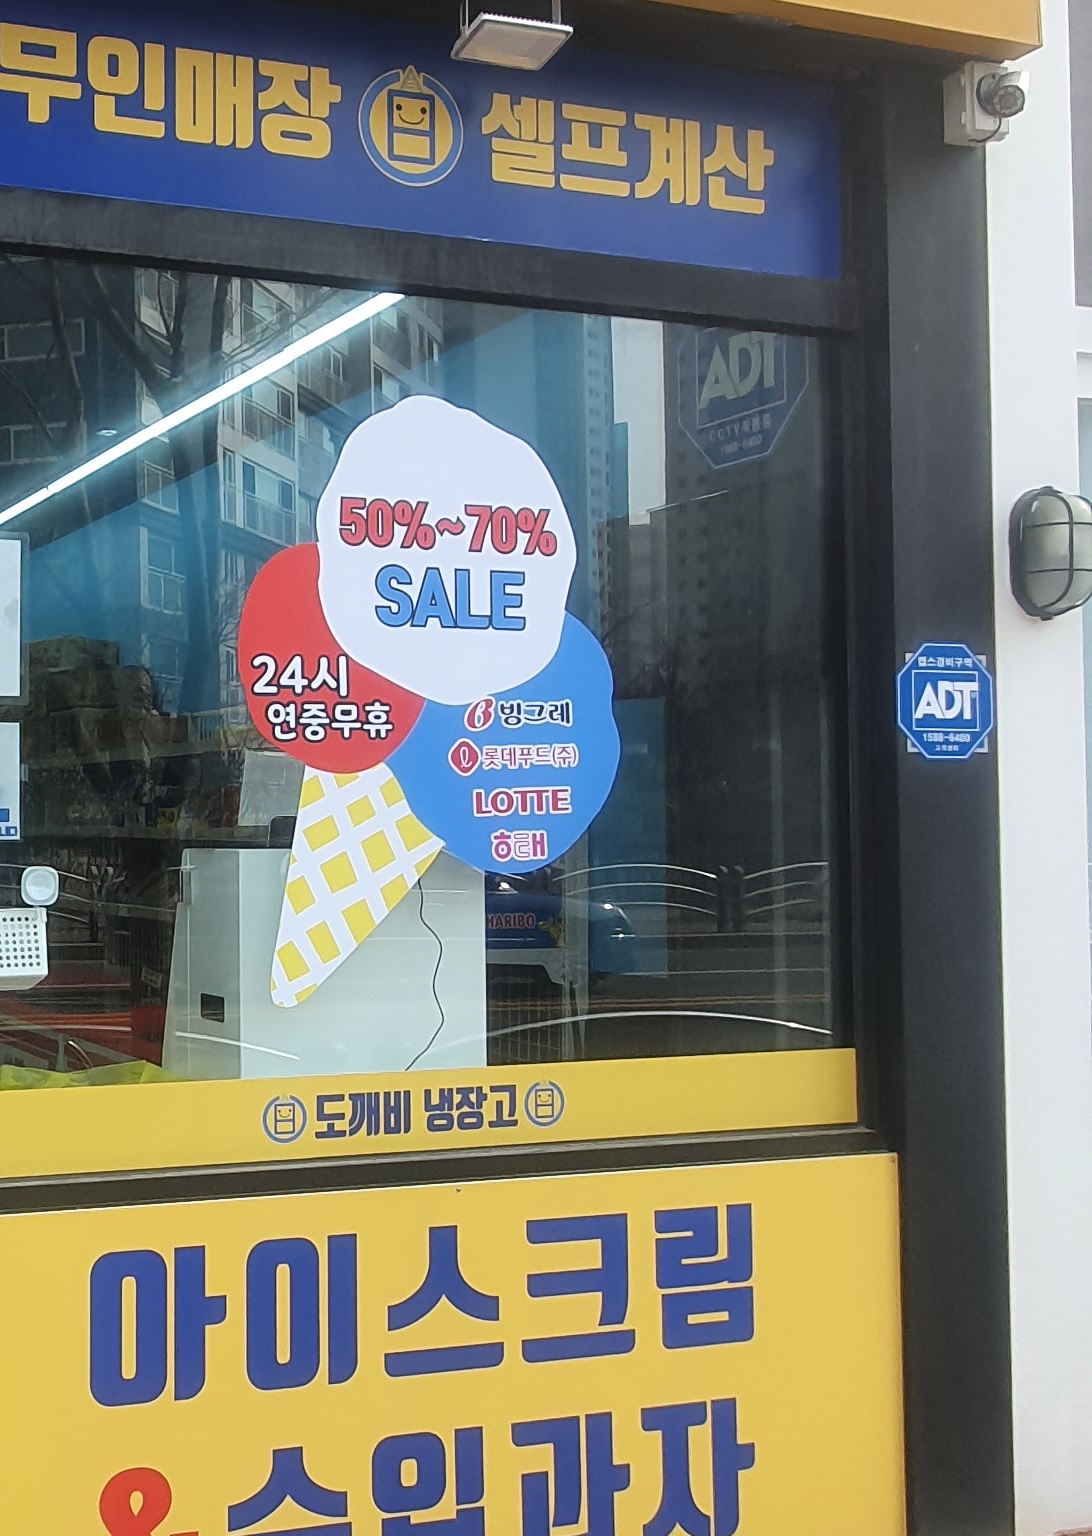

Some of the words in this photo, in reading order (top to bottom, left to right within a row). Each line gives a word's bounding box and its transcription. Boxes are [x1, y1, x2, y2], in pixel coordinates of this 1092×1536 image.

[480, 92, 775, 215] 셀프계산
[698, 330, 777, 409] ADT
[339, 496, 558, 556] 50%~70%
[374, 564, 527, 631] SALE
[251, 653, 349, 699] 24시
[266, 700, 395, 742] 연중무휴
[500, 701, 571, 726] 빙그레
[914, 680, 978, 719] ADT
[483, 745, 577, 768] 롯데푸드(주)
[475, 789, 570, 814] LOTTE
[486, 913, 535, 929] HARIBO
[314, 1089, 411, 1139] 도깨비
[423, 1084, 519, 1133] 냉장고
[88, 1203, 755, 1407] 아이스크림
